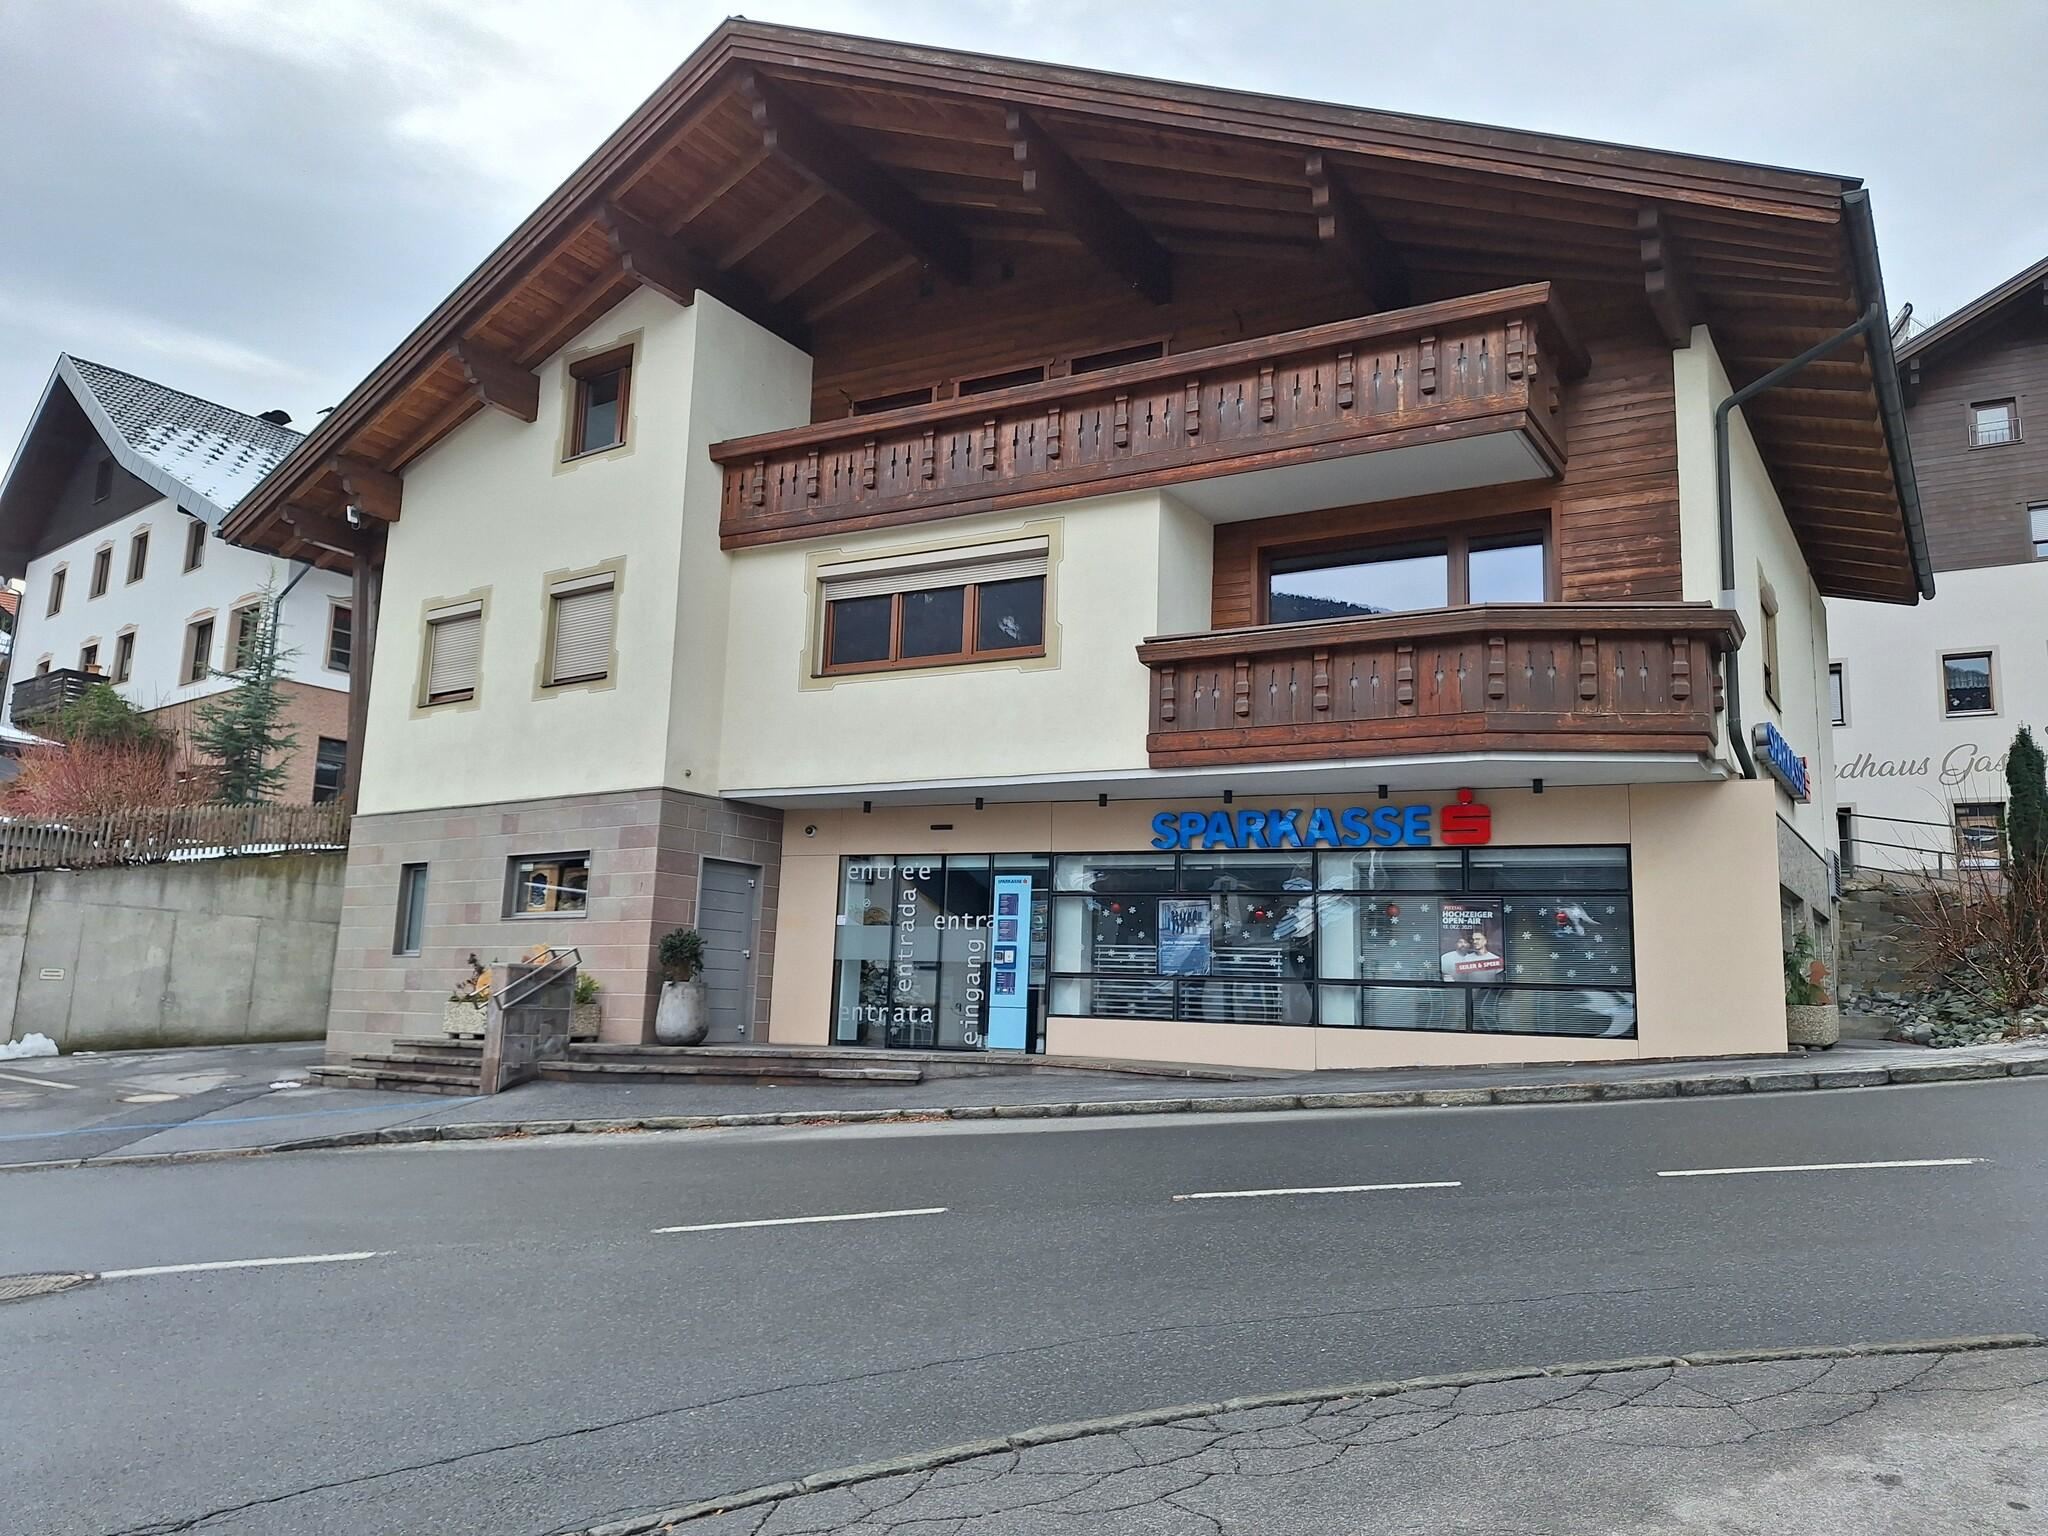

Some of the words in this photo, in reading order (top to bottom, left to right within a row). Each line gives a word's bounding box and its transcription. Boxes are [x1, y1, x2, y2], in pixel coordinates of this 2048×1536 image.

[1834, 752, 1930, 779] dhaus
[1151, 805, 1432, 850] SPARKASSE
[848, 863, 931, 880] entree
[1442, 911, 1493, 919] HOCHZEIGER
[898, 888, 917, 992] entrada
[960, 939, 986, 1045] eingang
[840, 1004, 933, 1023] entrata
